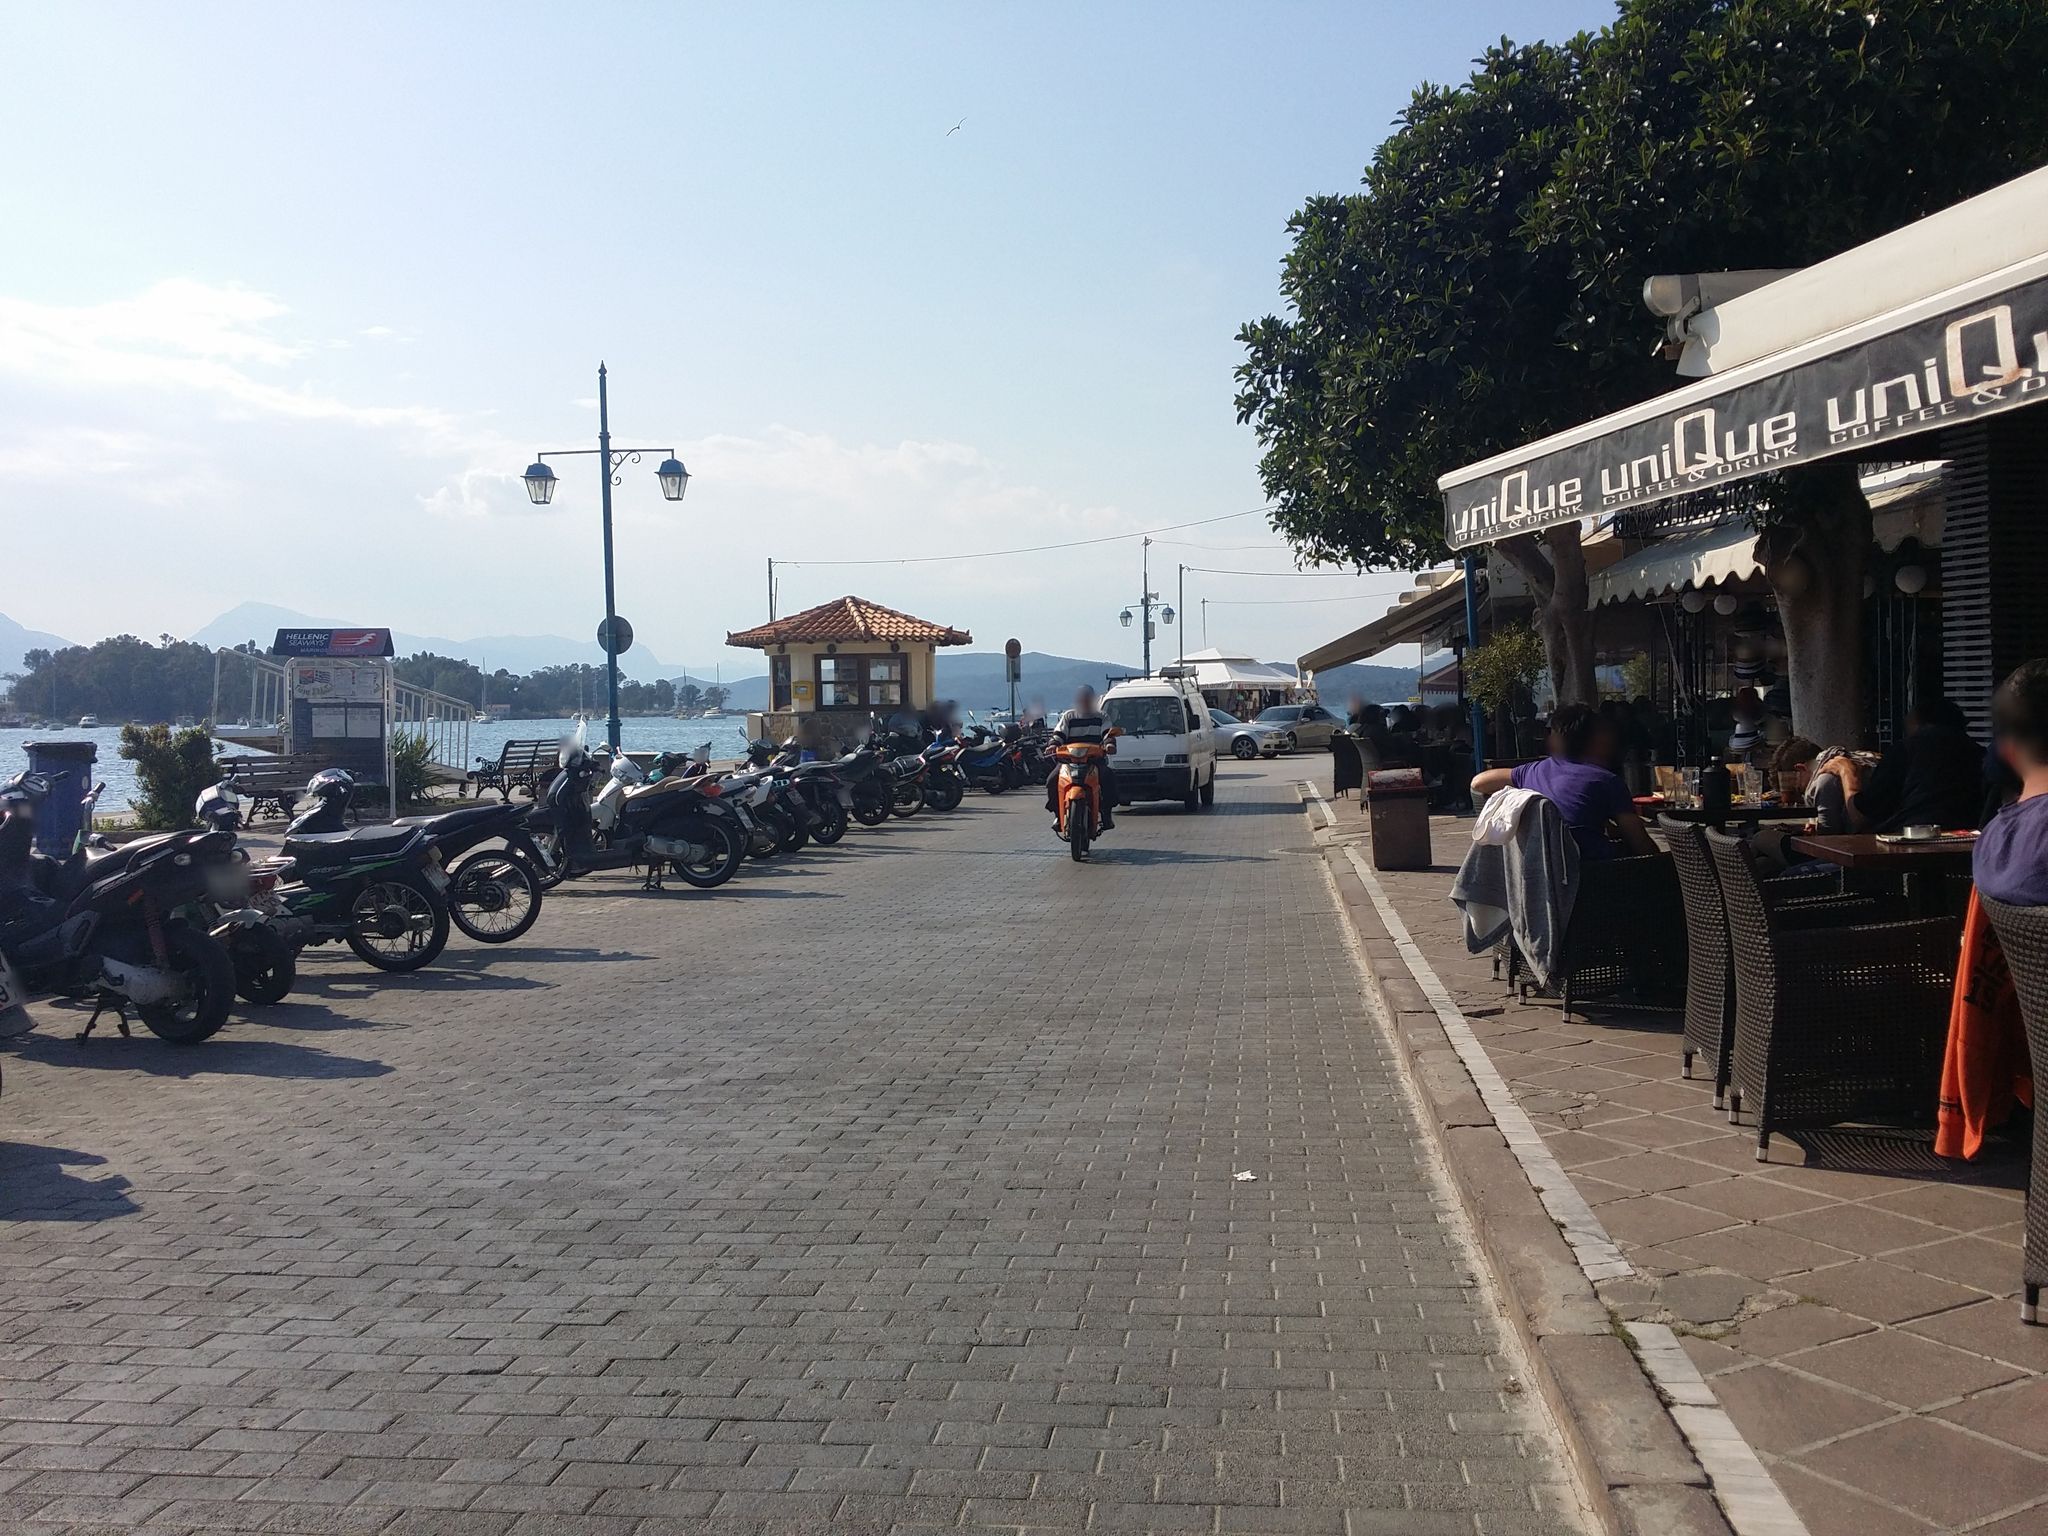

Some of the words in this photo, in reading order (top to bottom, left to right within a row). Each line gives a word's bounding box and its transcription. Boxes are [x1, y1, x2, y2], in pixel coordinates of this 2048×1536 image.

[1827, 304, 2048, 432] uniQ
[1830, 401, 1957, 444] COFFEE
[1973, 387, 2007, 405] &
[1601, 408, 1797, 496] uniQue
[1603, 478, 1681, 505] COFFEE
[1688, 466, 1707, 482] &
[1718, 445, 1798, 476] DRINK
[1452, 471, 1583, 536] uniQue
[1509, 518, 1523, 529] &
[1528, 504, 1583, 525] DRINK
[285, 633, 329, 641] HELLENIC
